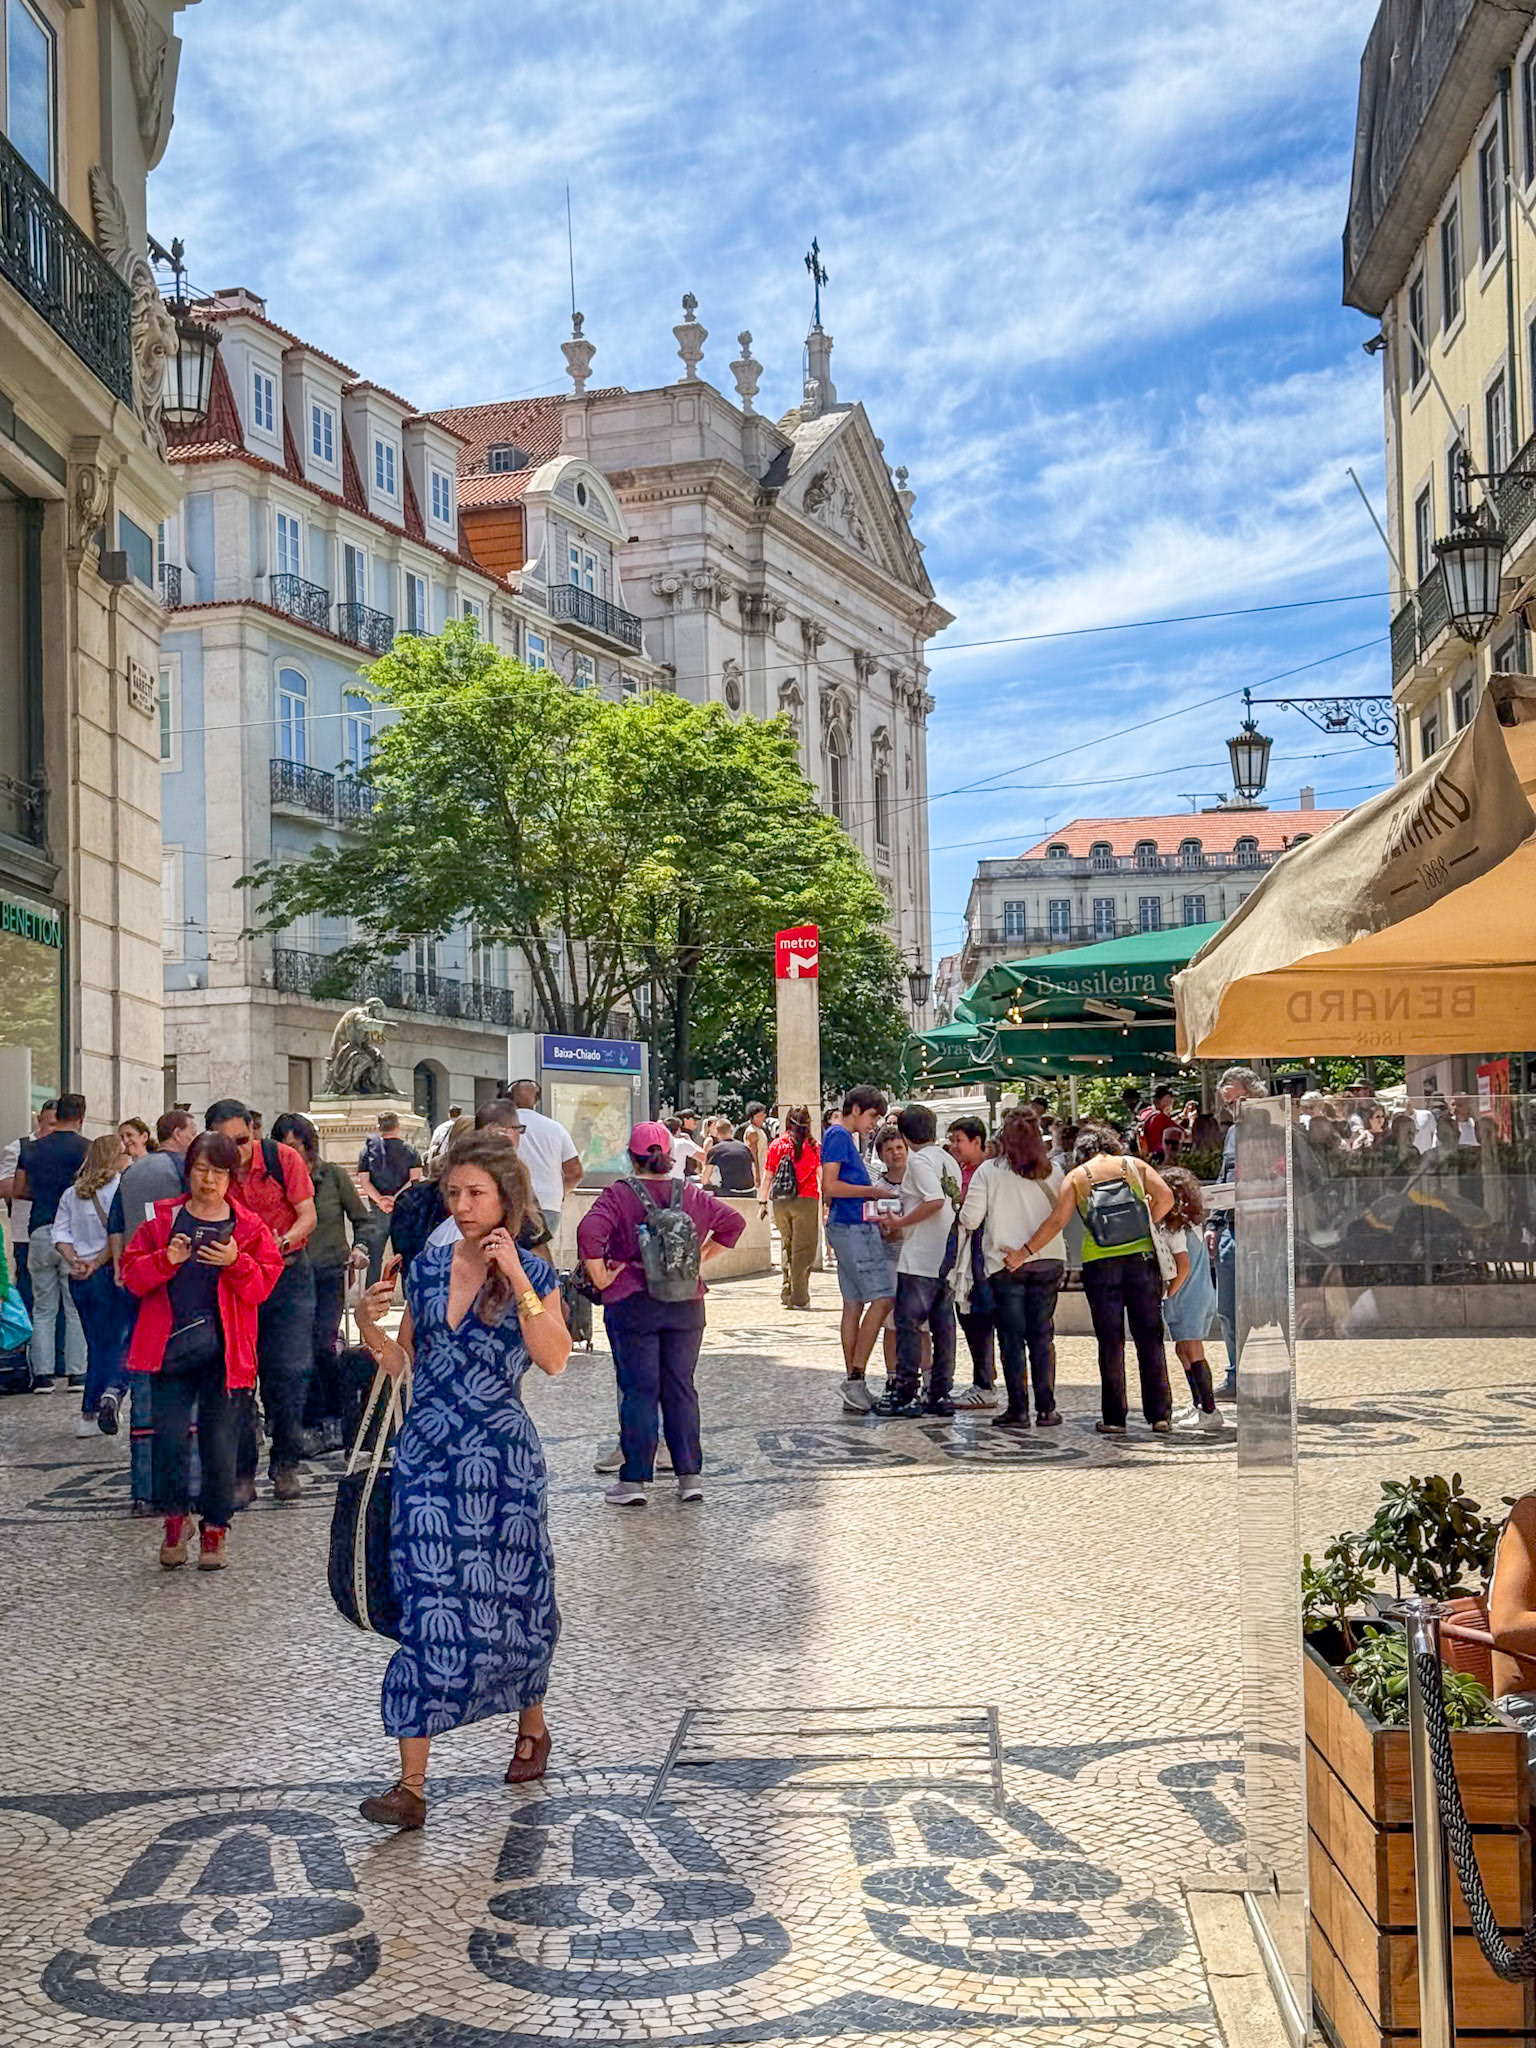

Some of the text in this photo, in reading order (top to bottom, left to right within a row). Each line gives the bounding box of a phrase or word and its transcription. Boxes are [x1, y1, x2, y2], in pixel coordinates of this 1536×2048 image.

[780, 936, 817, 949] metro
[1034, 968, 1157, 995] Brasileira
[553, 1046, 601, 1061] Baixa-Chiado
